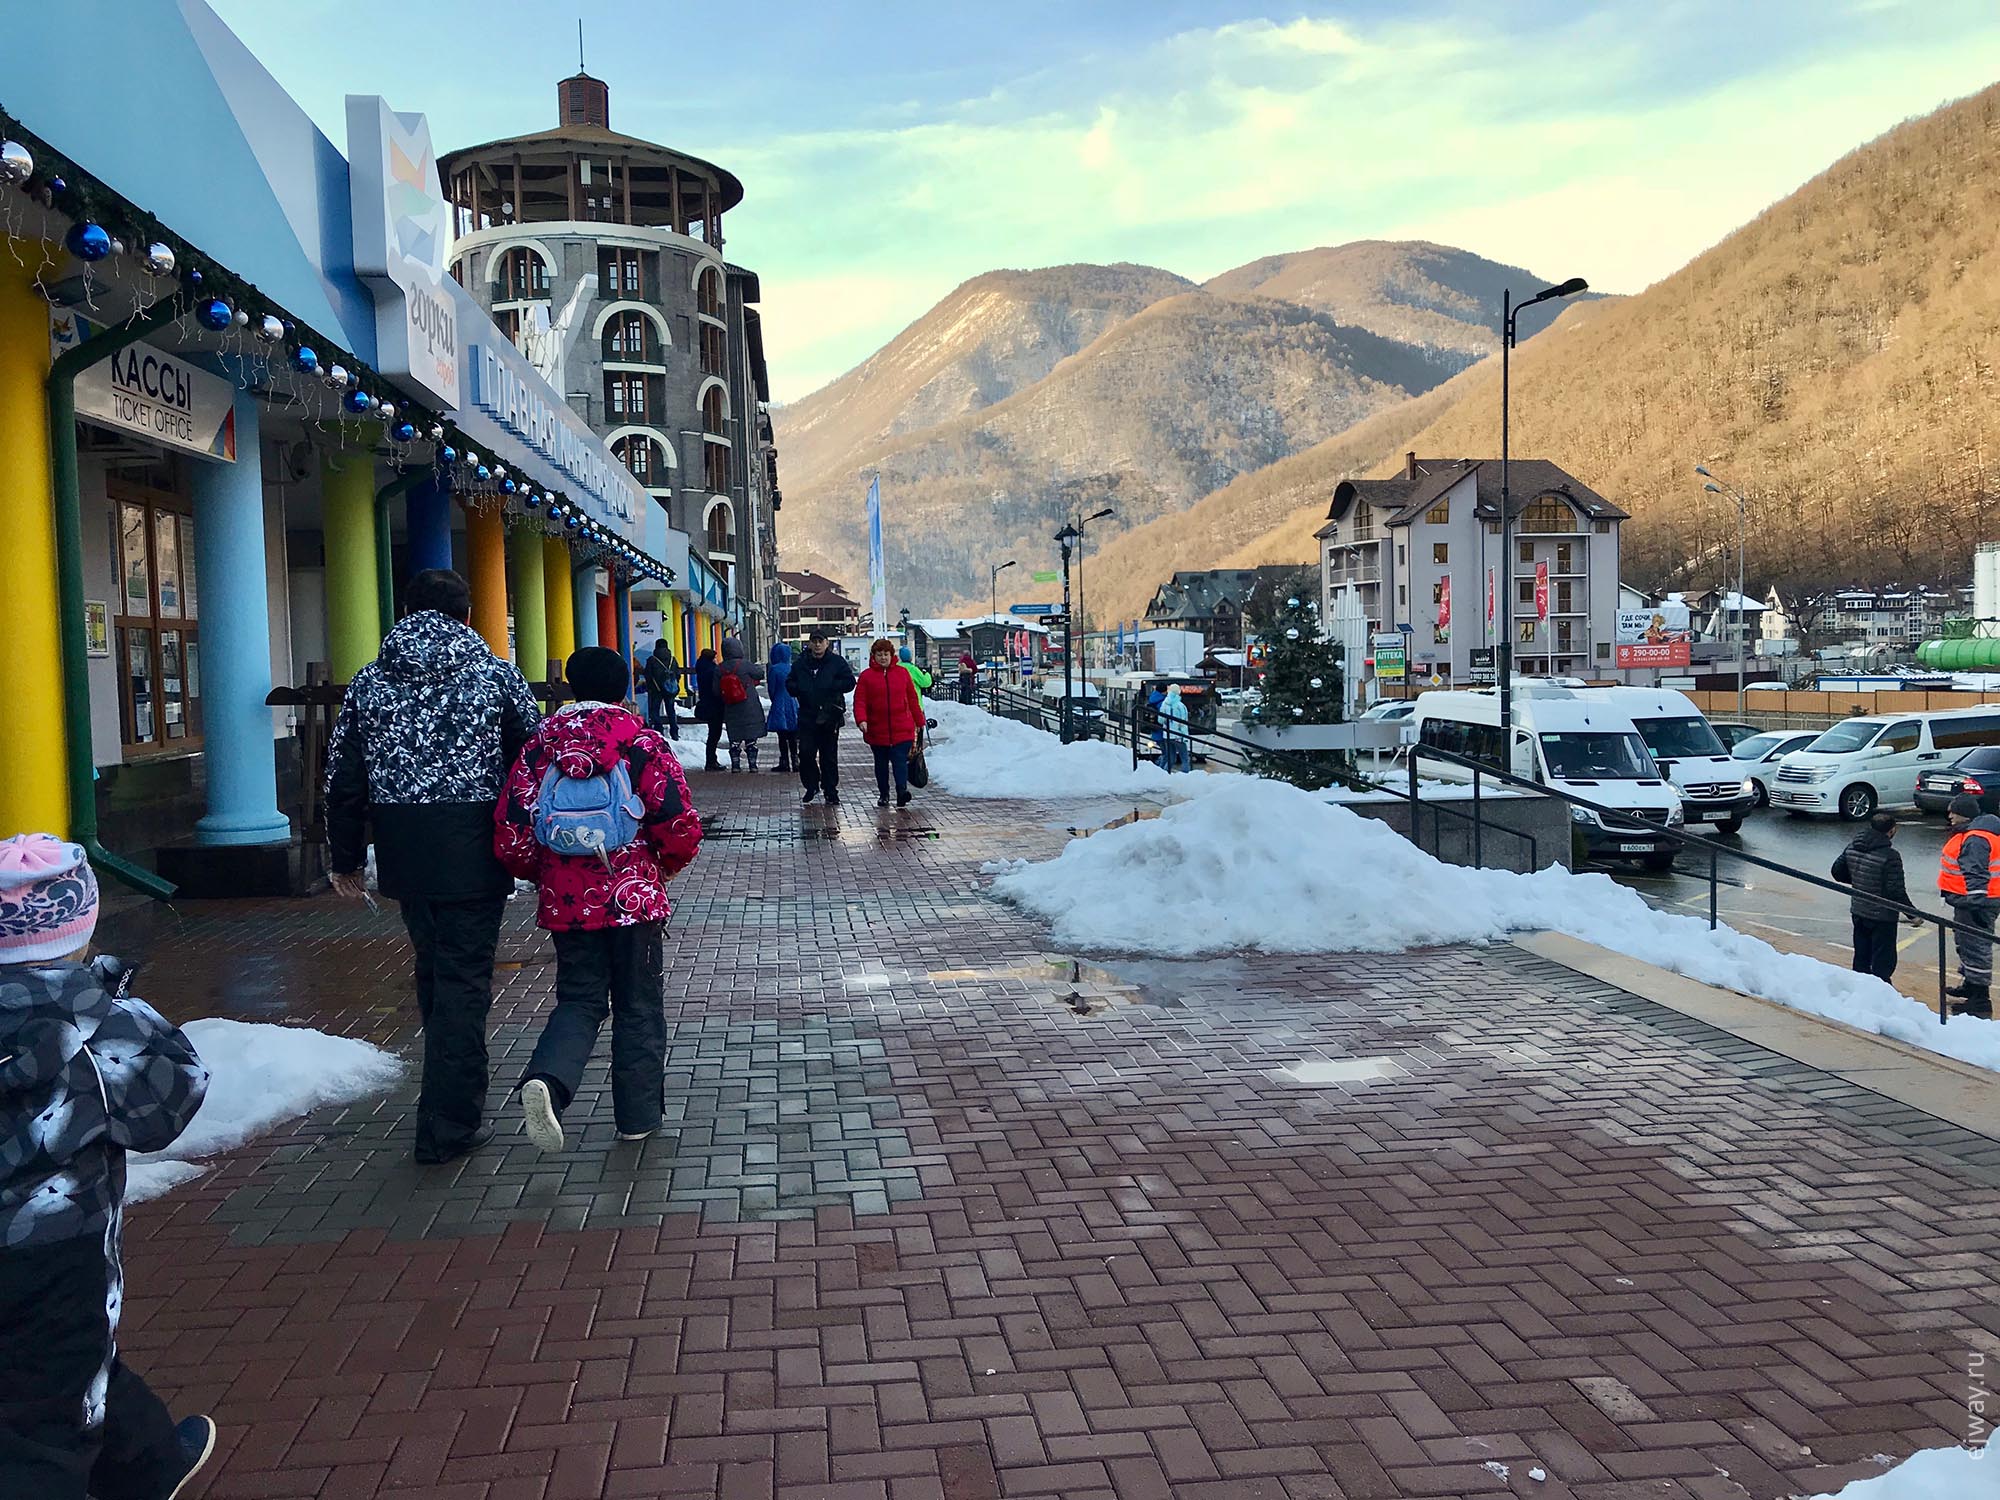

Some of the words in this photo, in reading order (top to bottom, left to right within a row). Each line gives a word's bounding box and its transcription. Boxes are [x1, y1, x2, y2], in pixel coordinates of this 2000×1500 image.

[410, 281, 454, 357] горки
[111, 348, 192, 411] КАССЫ
[470, 344, 558, 461] ГЛАВНАЯ
[113, 393, 151, 428] TICKET
[154, 408, 193, 442] OFFICE
[1377, 651, 1403, 660] АПТЕКА
[1633, 648, 1670, 657] 290-00-00
